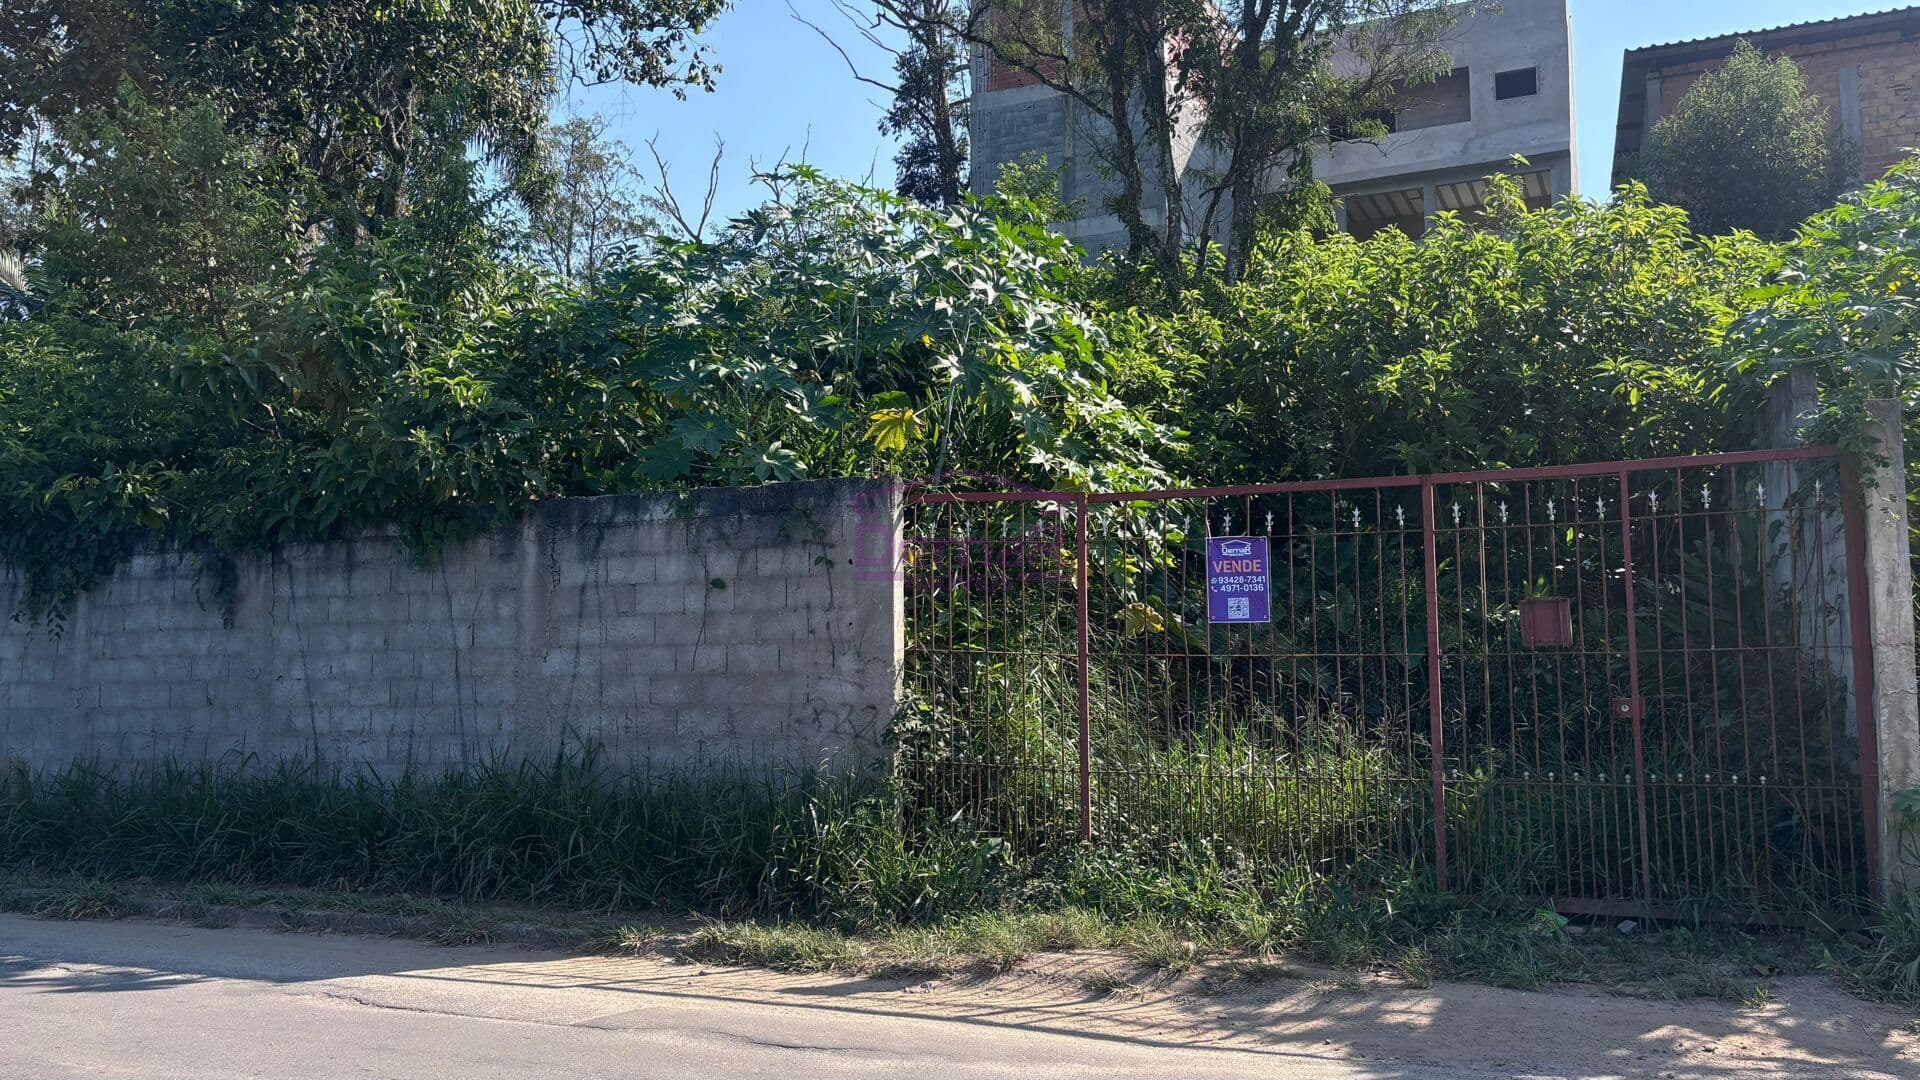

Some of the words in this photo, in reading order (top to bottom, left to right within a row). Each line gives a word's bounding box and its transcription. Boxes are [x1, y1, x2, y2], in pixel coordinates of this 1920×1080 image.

[1213, 560, 1262, 573] VENDE
[1218, 575, 1266, 584] 93428-7341
[1220, 583, 1264, 592] 4971-0136
